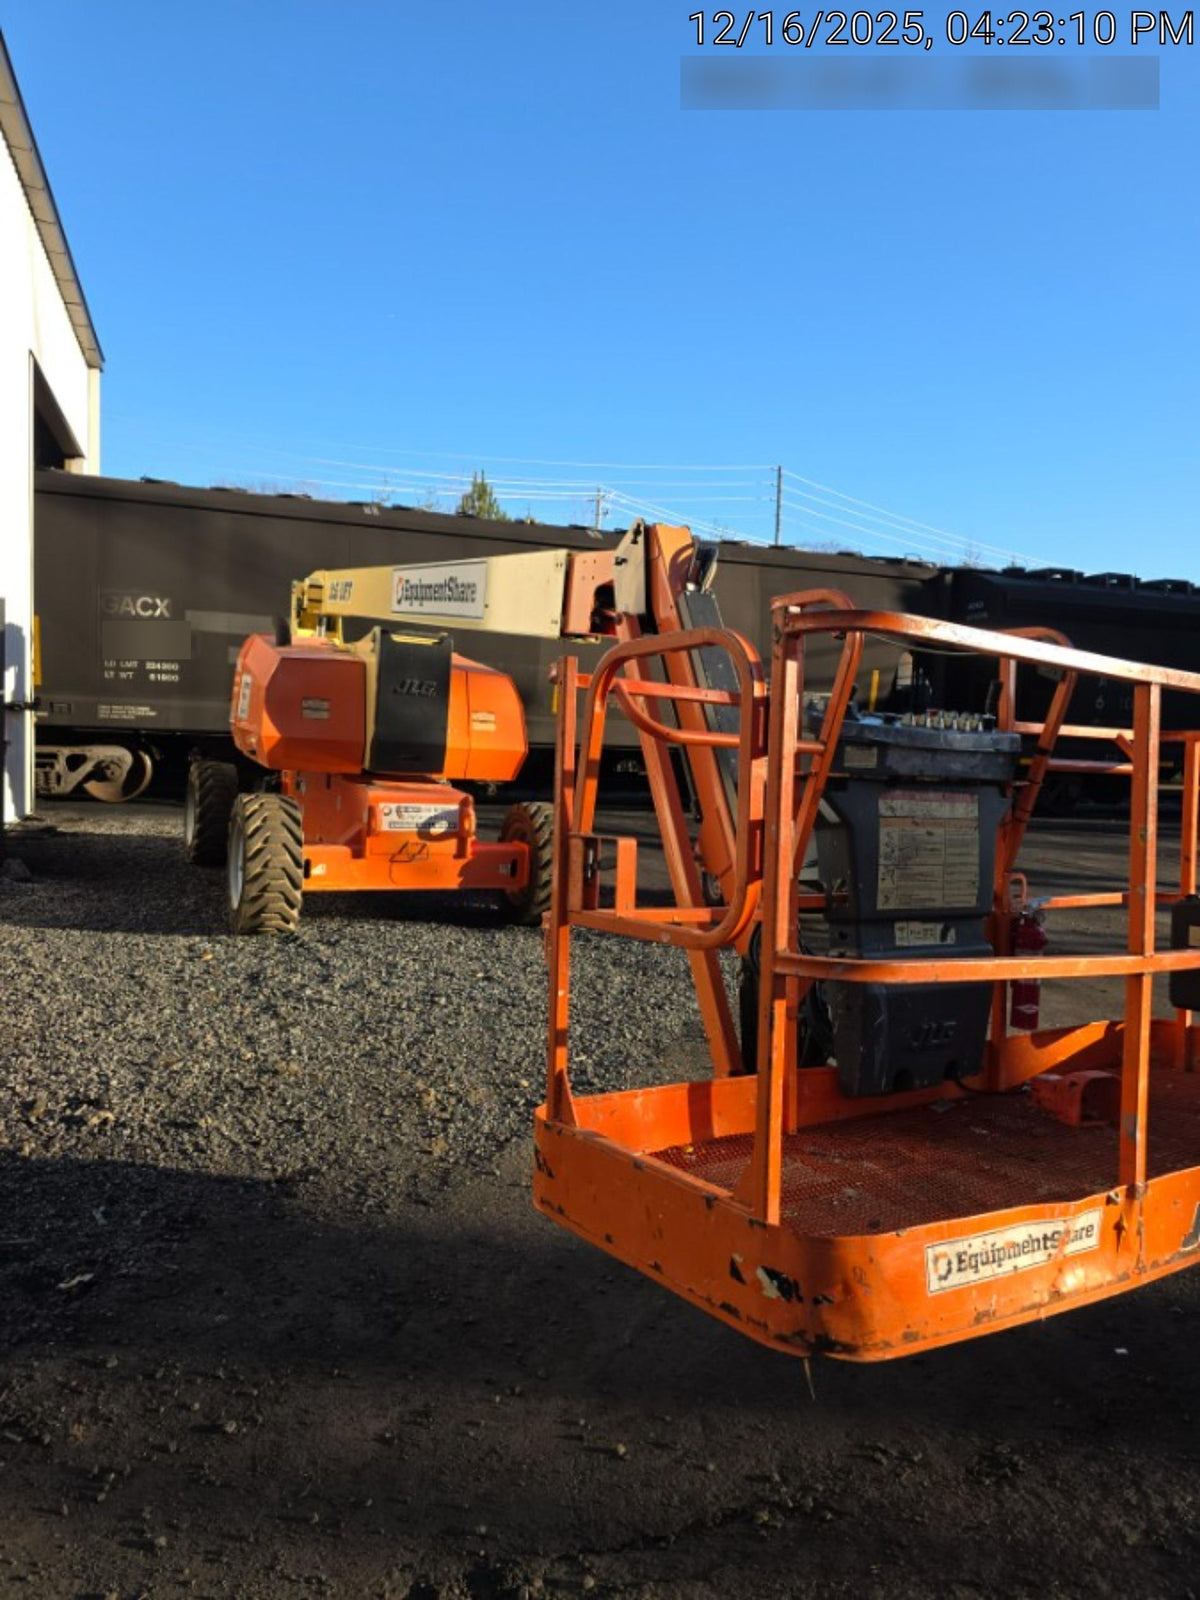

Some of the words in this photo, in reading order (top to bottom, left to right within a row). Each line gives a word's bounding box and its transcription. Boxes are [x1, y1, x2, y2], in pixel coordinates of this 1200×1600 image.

[405, 576, 476, 607] EquipmentShare
[394, 678, 437, 697] JLG
[956, 1222, 1095, 1274] EquipmentSare
